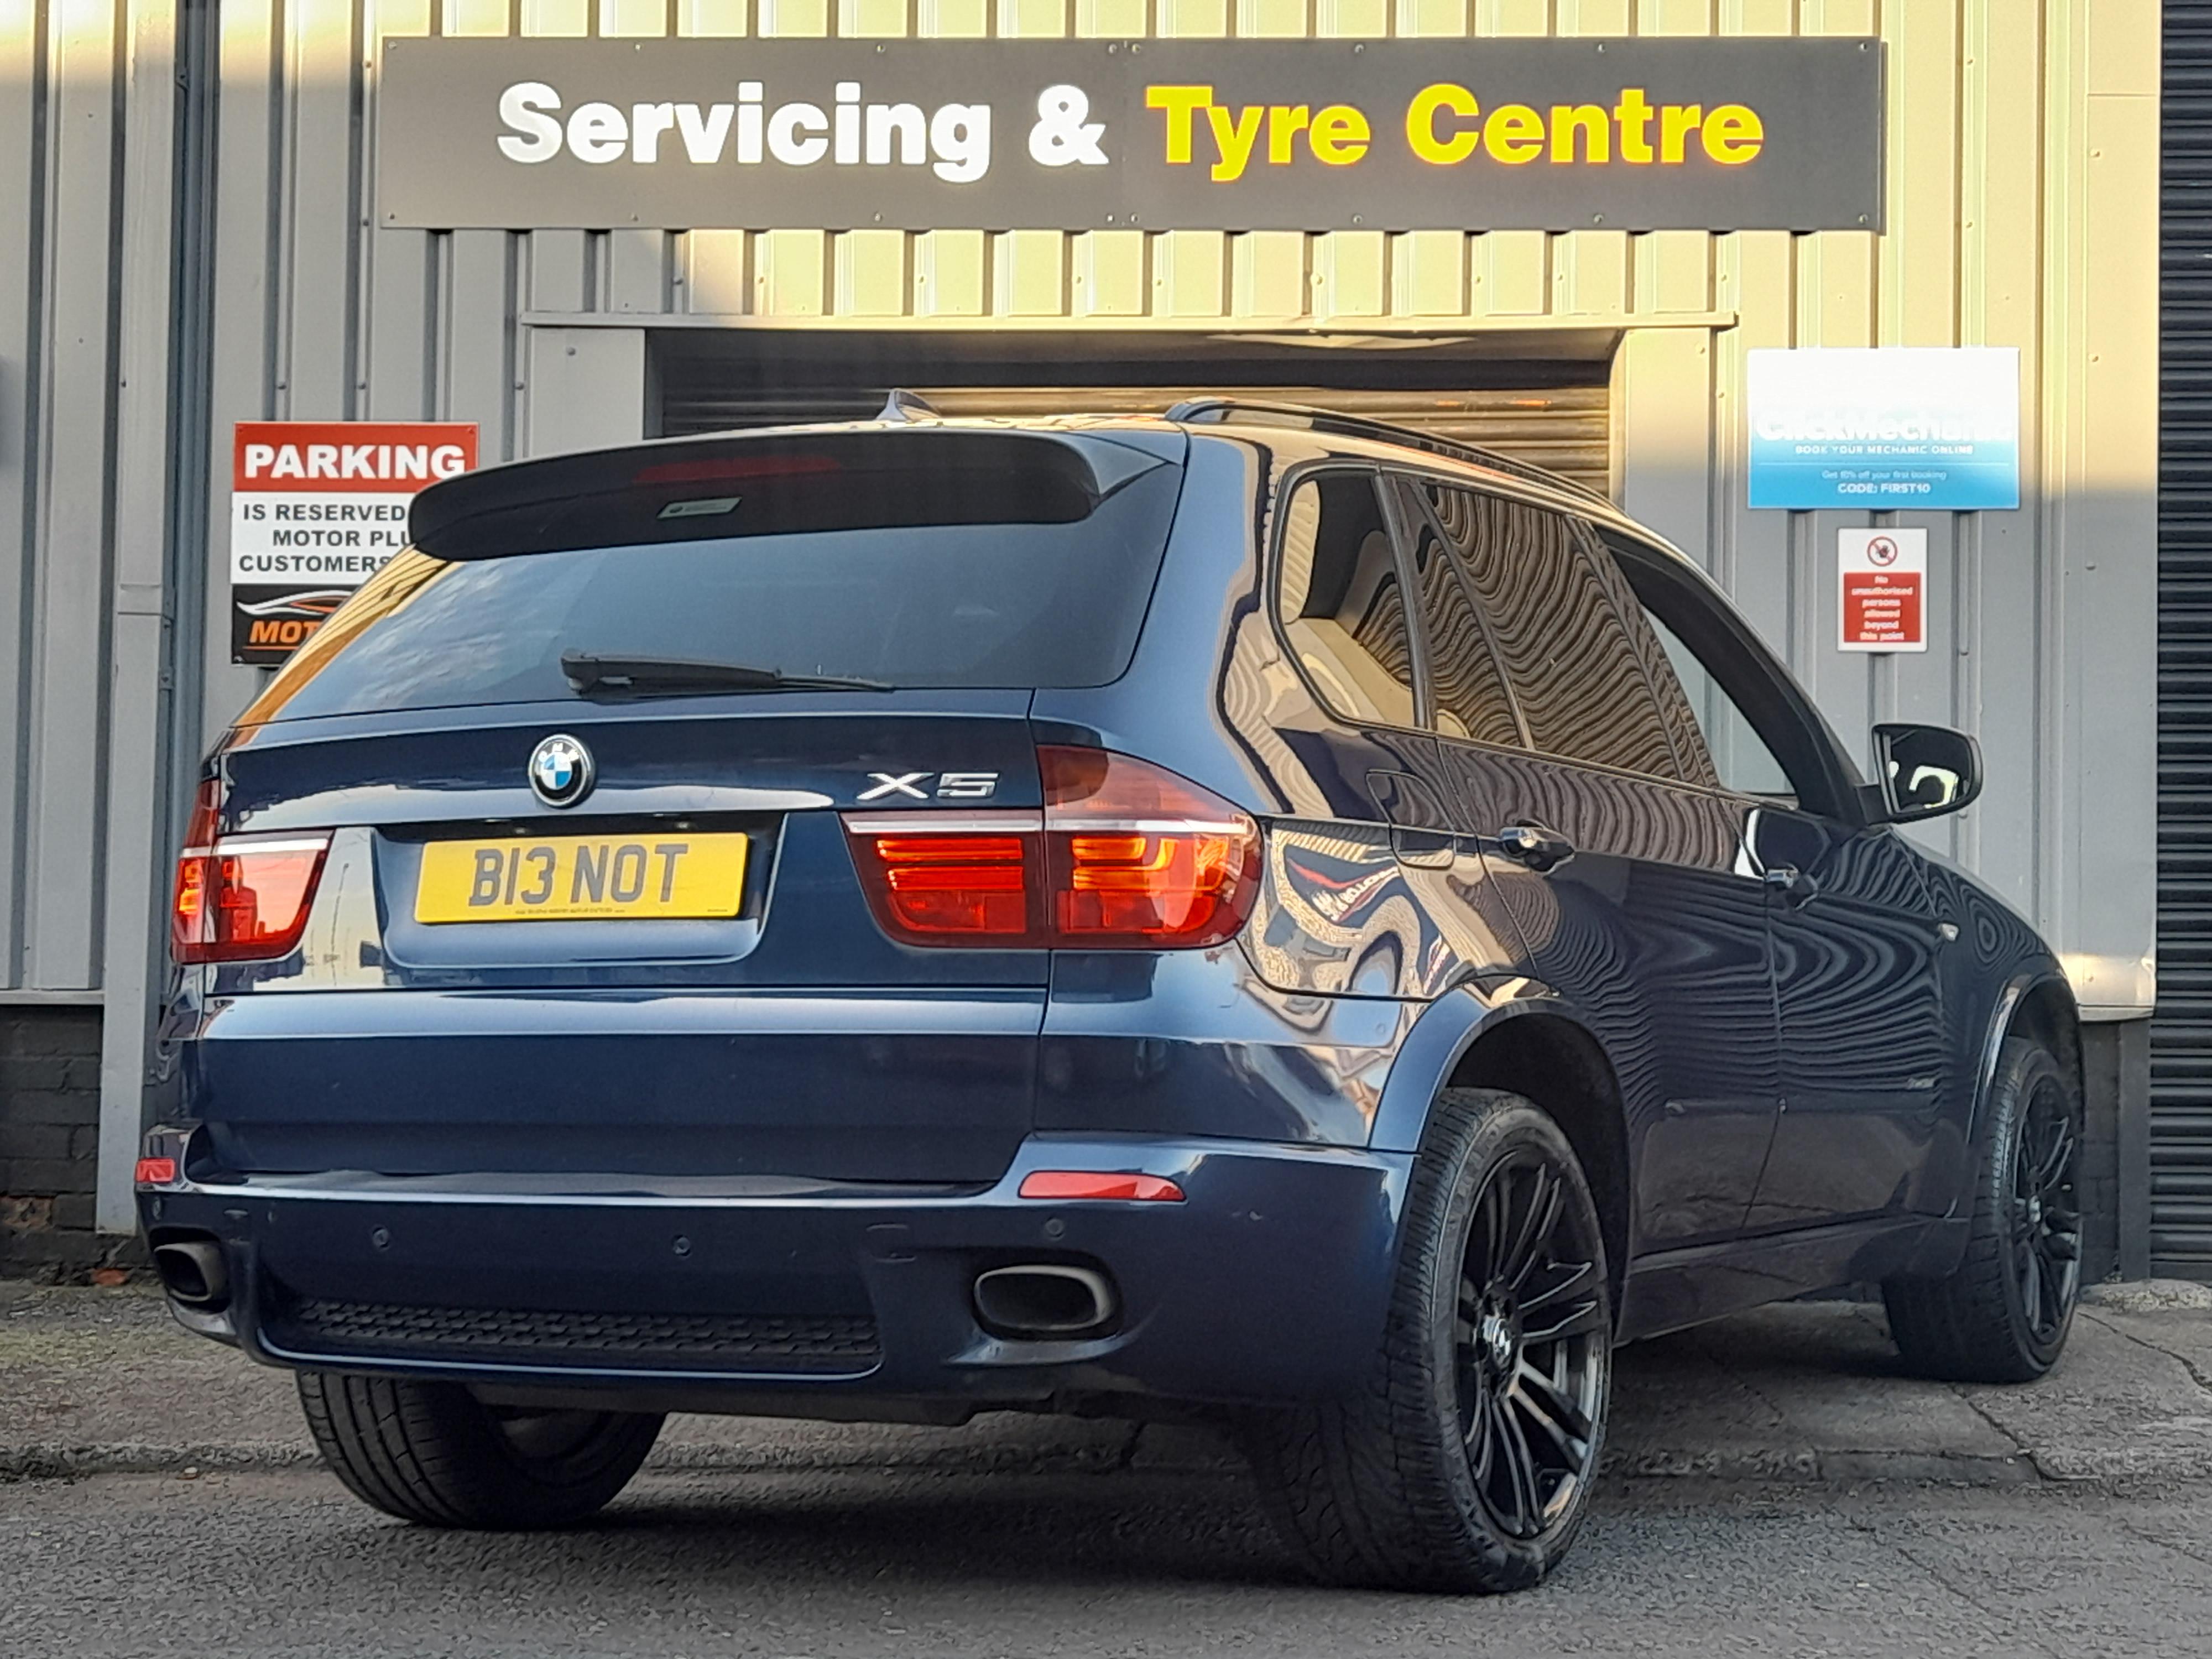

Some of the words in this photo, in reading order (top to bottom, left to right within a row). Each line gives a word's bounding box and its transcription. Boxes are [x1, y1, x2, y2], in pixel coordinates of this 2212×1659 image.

[497, 81, 990, 183] Servicing
[1029, 85, 1109, 166] &
[1146, 86, 1371, 181] Tyre
[1406, 83, 1764, 165] Centre
[1796, 445, 1828, 454] BOOK
[1832, 445, 1863, 454] YOUR
[1867, 445, 1927, 454] MECHANIC
[1931, 445, 1973, 455] ONLINE
[244, 445, 466, 479] PARKING
[1911, 470, 1947, 481] booking
[1838, 483, 1877, 493] CODE:
[1880, 483, 1931, 493] FIRST10
[244, 504, 266, 520] IS
[276, 505, 405, 521] RESERVED
[273, 530, 360, 546] MOTOR
[239, 555, 389, 572] CUSTOMERS
[857, 773, 998, 800] X5
[570, 843, 688, 904] NOT
